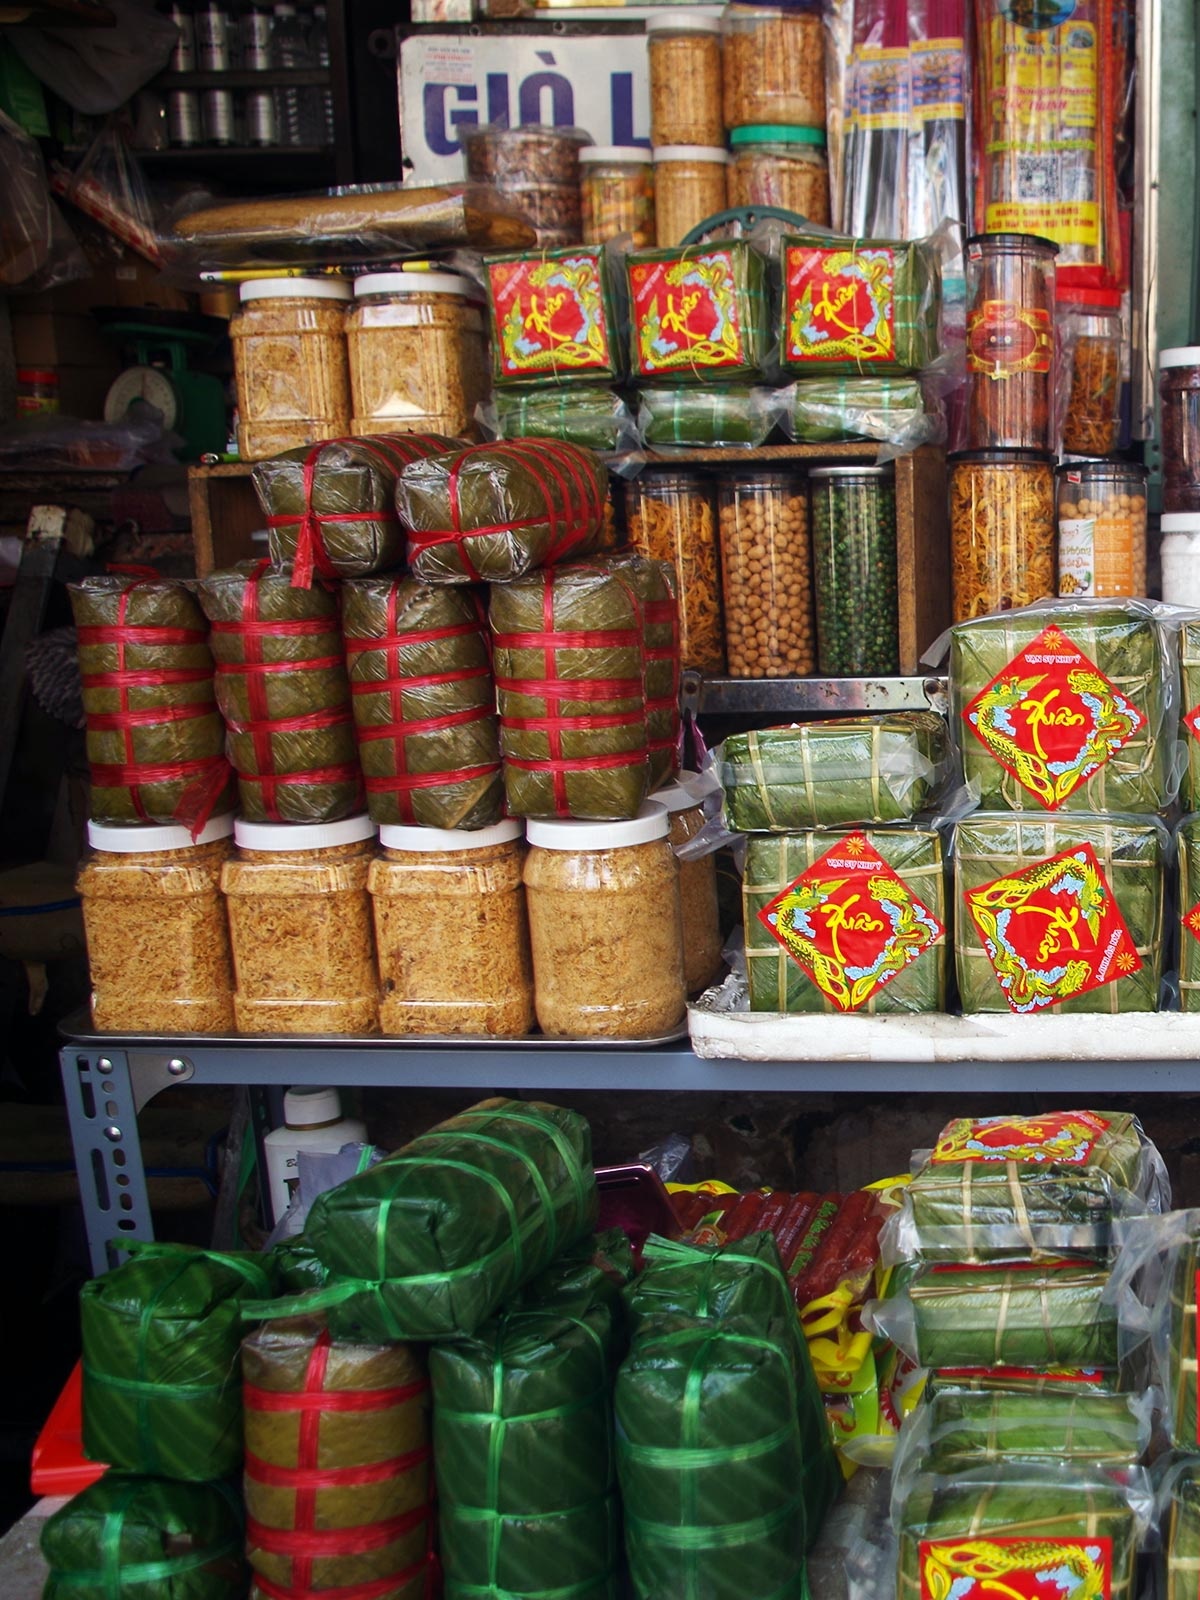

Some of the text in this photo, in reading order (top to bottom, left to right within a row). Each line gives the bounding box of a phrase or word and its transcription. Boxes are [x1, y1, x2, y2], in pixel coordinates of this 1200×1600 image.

[423, 51, 575, 156] GIÒ
[1021, 689, 1085, 760] Xuân
[820, 894, 884, 964] Xuân
